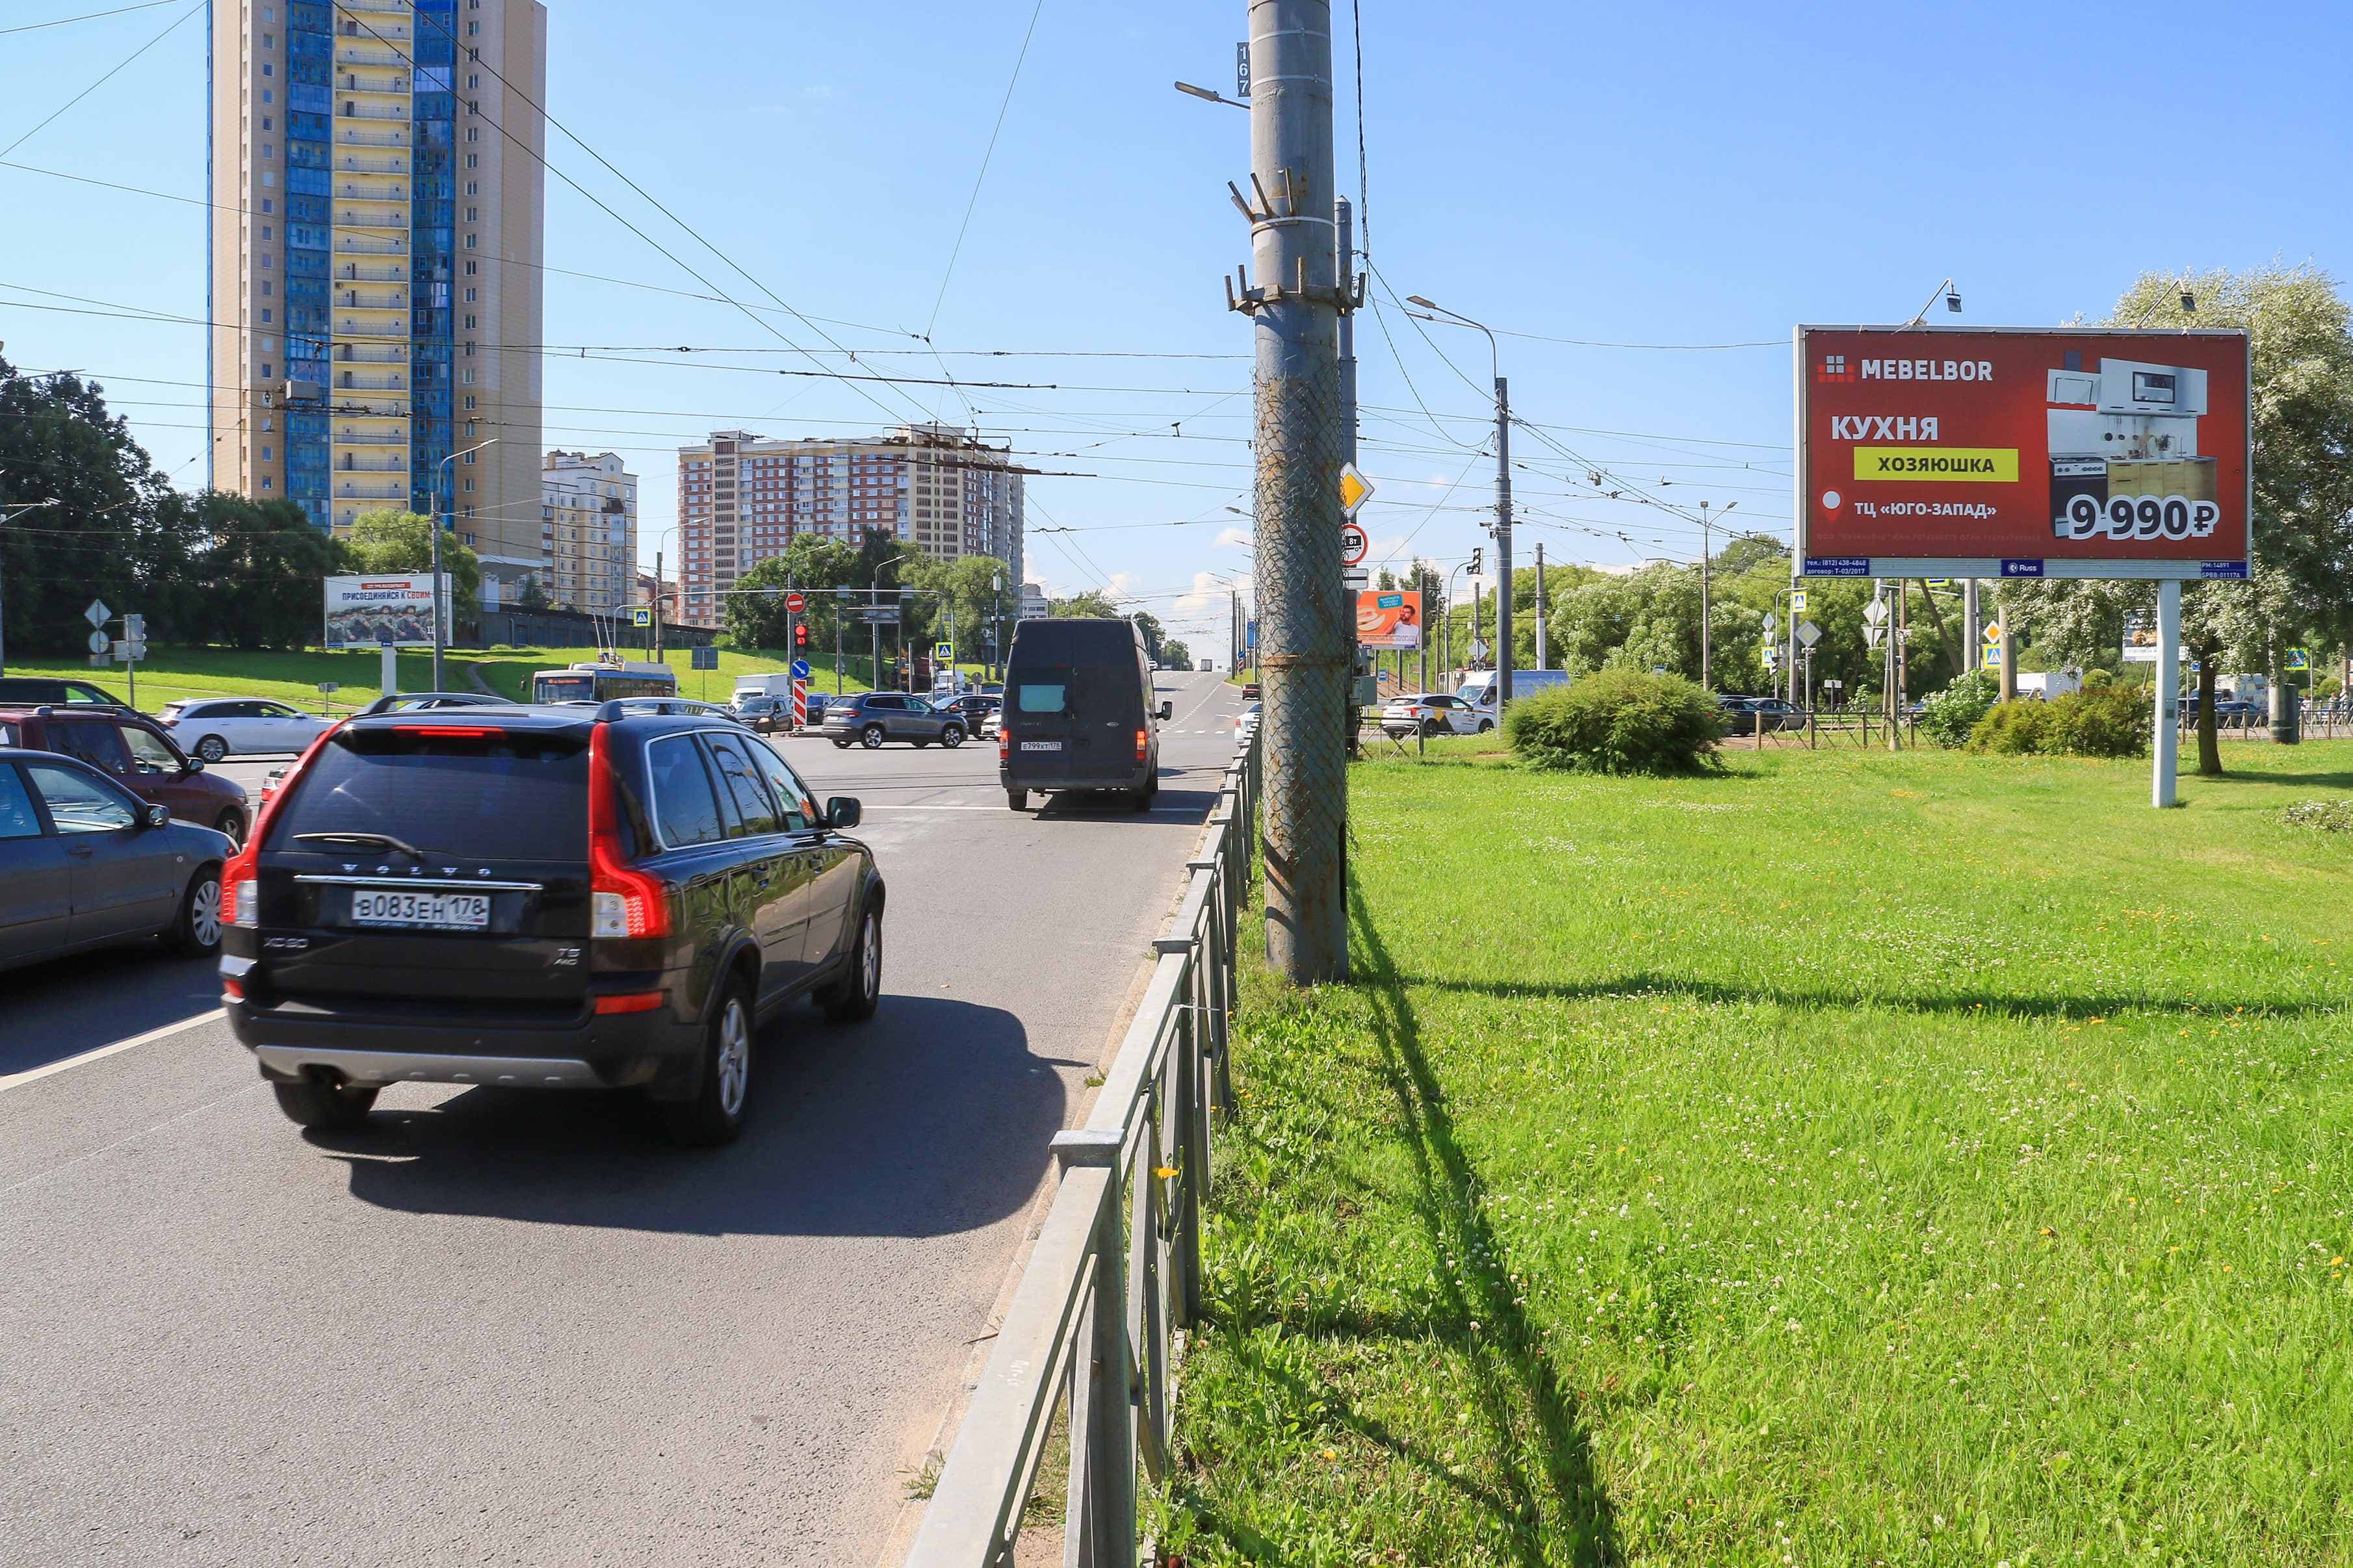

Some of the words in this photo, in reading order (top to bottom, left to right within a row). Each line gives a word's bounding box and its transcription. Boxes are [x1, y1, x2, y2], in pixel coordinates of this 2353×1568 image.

[1239, 46, 1249, 94] 167
[1861, 359, 1994, 381] MEBELBOR
[1831, 415, 1938, 441] КУХНЯ
[1877, 457, 1995, 473] ХОЗЯЮШКА
[1854, 502, 1877, 518] ТЦ
[1880, 502, 1997, 519] «ЮГО-ЗАПАД»
[342, 591, 399, 600] ПРИСОЕДИНЯЙСЯ
[407, 591, 430, 599] СВОИМ
[359, 894, 445, 920] В083ЕН
[450, 897, 483, 915] 178
